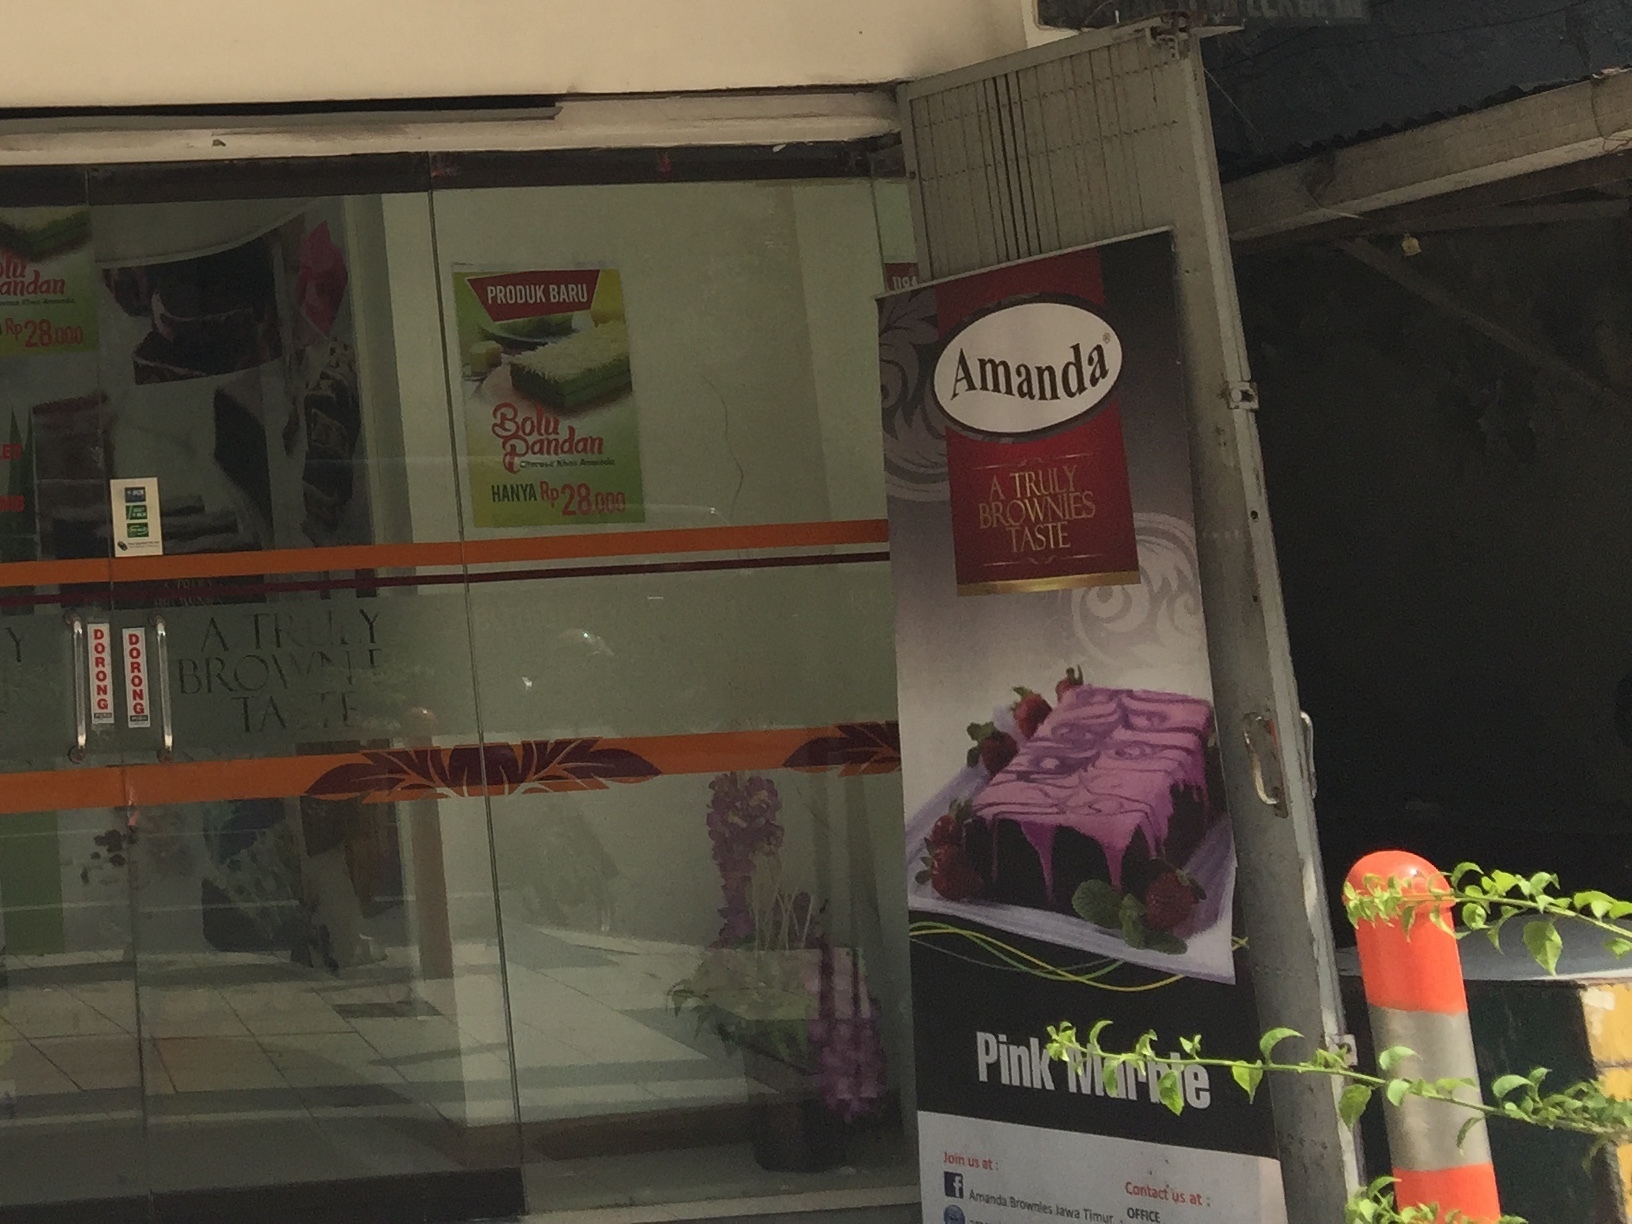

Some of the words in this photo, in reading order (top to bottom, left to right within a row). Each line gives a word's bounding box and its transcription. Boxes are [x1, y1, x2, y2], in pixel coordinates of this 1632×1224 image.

[487, 284, 546, 305] PRODUK
[549, 283, 588, 304] BARU
[950, 342, 1110, 401] Amanda
[491, 402, 560, 439] Bolu
[502, 426, 604, 475] Pandan
[491, 483, 537, 503] HANYA
[988, 474, 1006, 501] A
[1009, 464, 1078, 499] TRULY
[978, 491, 1096, 529] BROWNIES
[1005, 522, 1071, 553] TASTE
[201, 617, 229, 652] A
[93, 628, 109, 710] DORONG
[128, 633, 145, 715] DORONG
[976, 1031, 1055, 1091] Pink
[943, 1151, 965, 1166] Join
[968, 1157, 980, 1169] us
[982, 1158, 993, 1170] at
[968, 1189, 1007, 1208] Amanda
[1009, 1196, 1053, 1215] Brownies
[1055, 1204, 1080, 1219] Jawa
[1083, 1207, 1113, 1223] Timur
[1125, 1181, 1168, 1200] Contact
[1171, 1190, 1185, 1204] us
[1189, 1192, 1203, 1206] at
[1126, 1206, 1161, 1223] OFFICE
